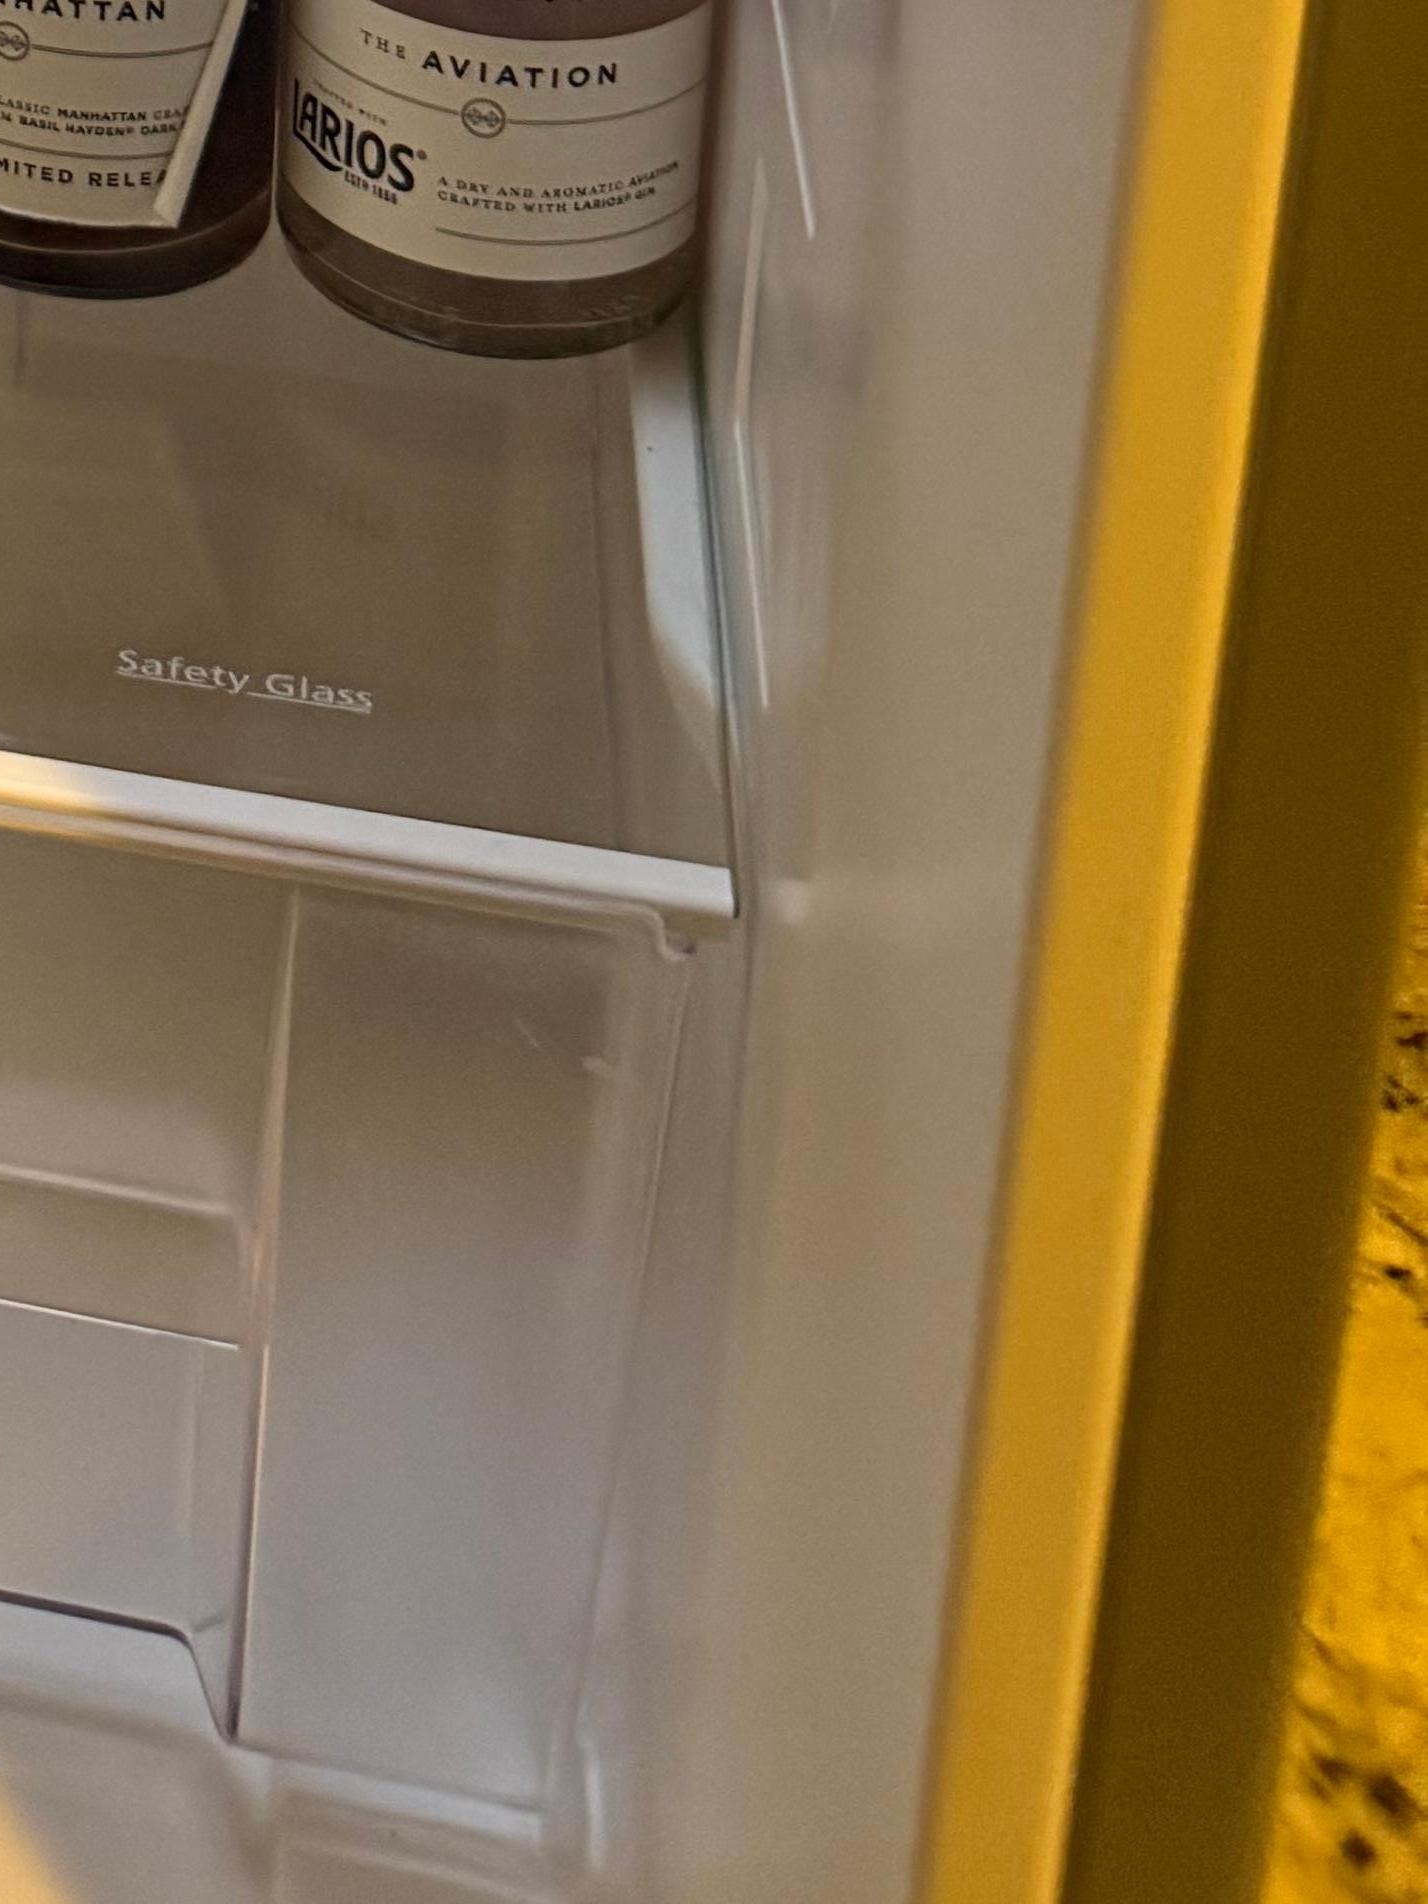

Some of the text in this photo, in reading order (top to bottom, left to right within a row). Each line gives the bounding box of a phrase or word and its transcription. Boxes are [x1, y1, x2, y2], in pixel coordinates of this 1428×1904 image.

[359, 26, 620, 90] THE AVIATION
[19, 115, 61, 132] BASIL
[56, 107, 147, 123] MANHATTAN
[292, 76, 416, 193] LARIOS
[437, 176, 448, 187] A
[455, 178, 490, 194] DRY
[496, 185, 534, 199] AND
[539, 179, 625, 199] AROMATIC
[436, 189, 516, 213] CRAFTED
[522, 201, 567, 214] WITH
[115, 648, 374, 712] Safety Glass
